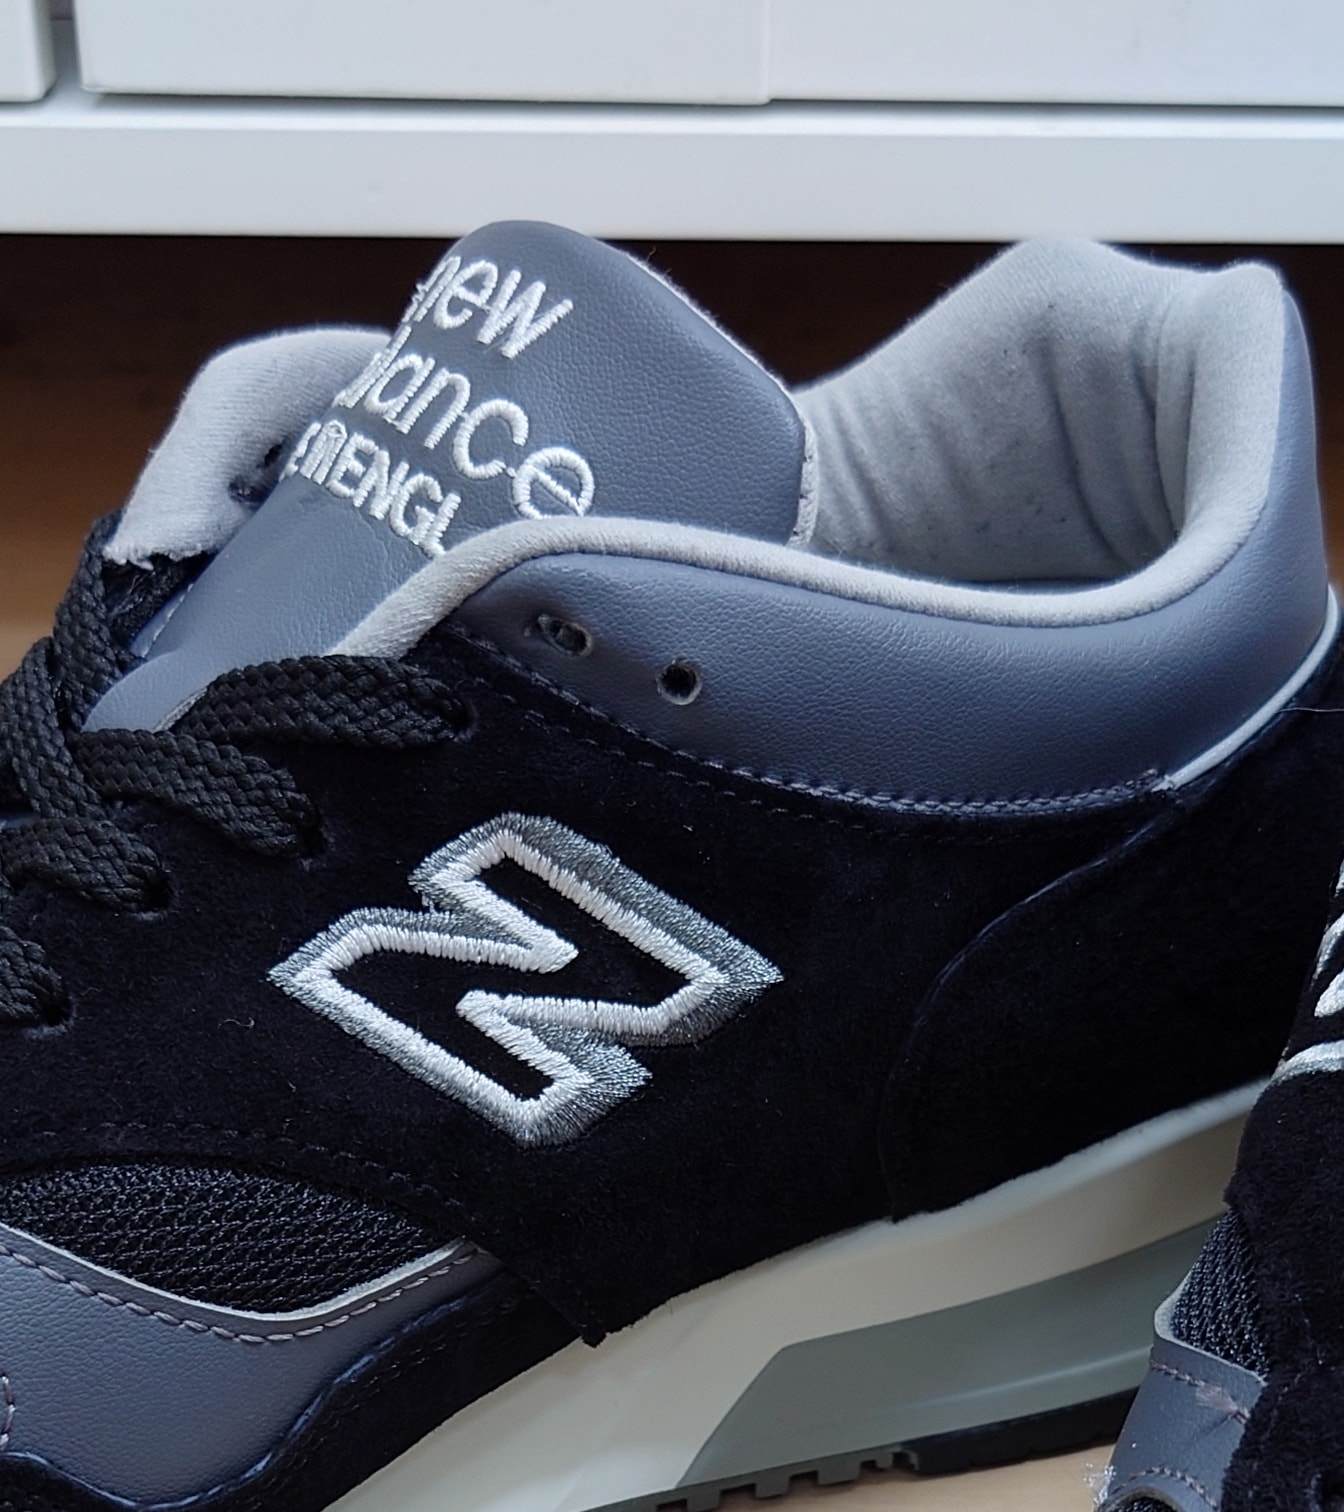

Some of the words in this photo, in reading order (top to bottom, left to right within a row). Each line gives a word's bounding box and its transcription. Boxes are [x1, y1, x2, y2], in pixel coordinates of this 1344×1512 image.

[401, 256, 572, 359] new
[324, 431, 462, 558] ENGL
[332, 326, 595, 518] lance
[266, 811, 785, 1148] N
